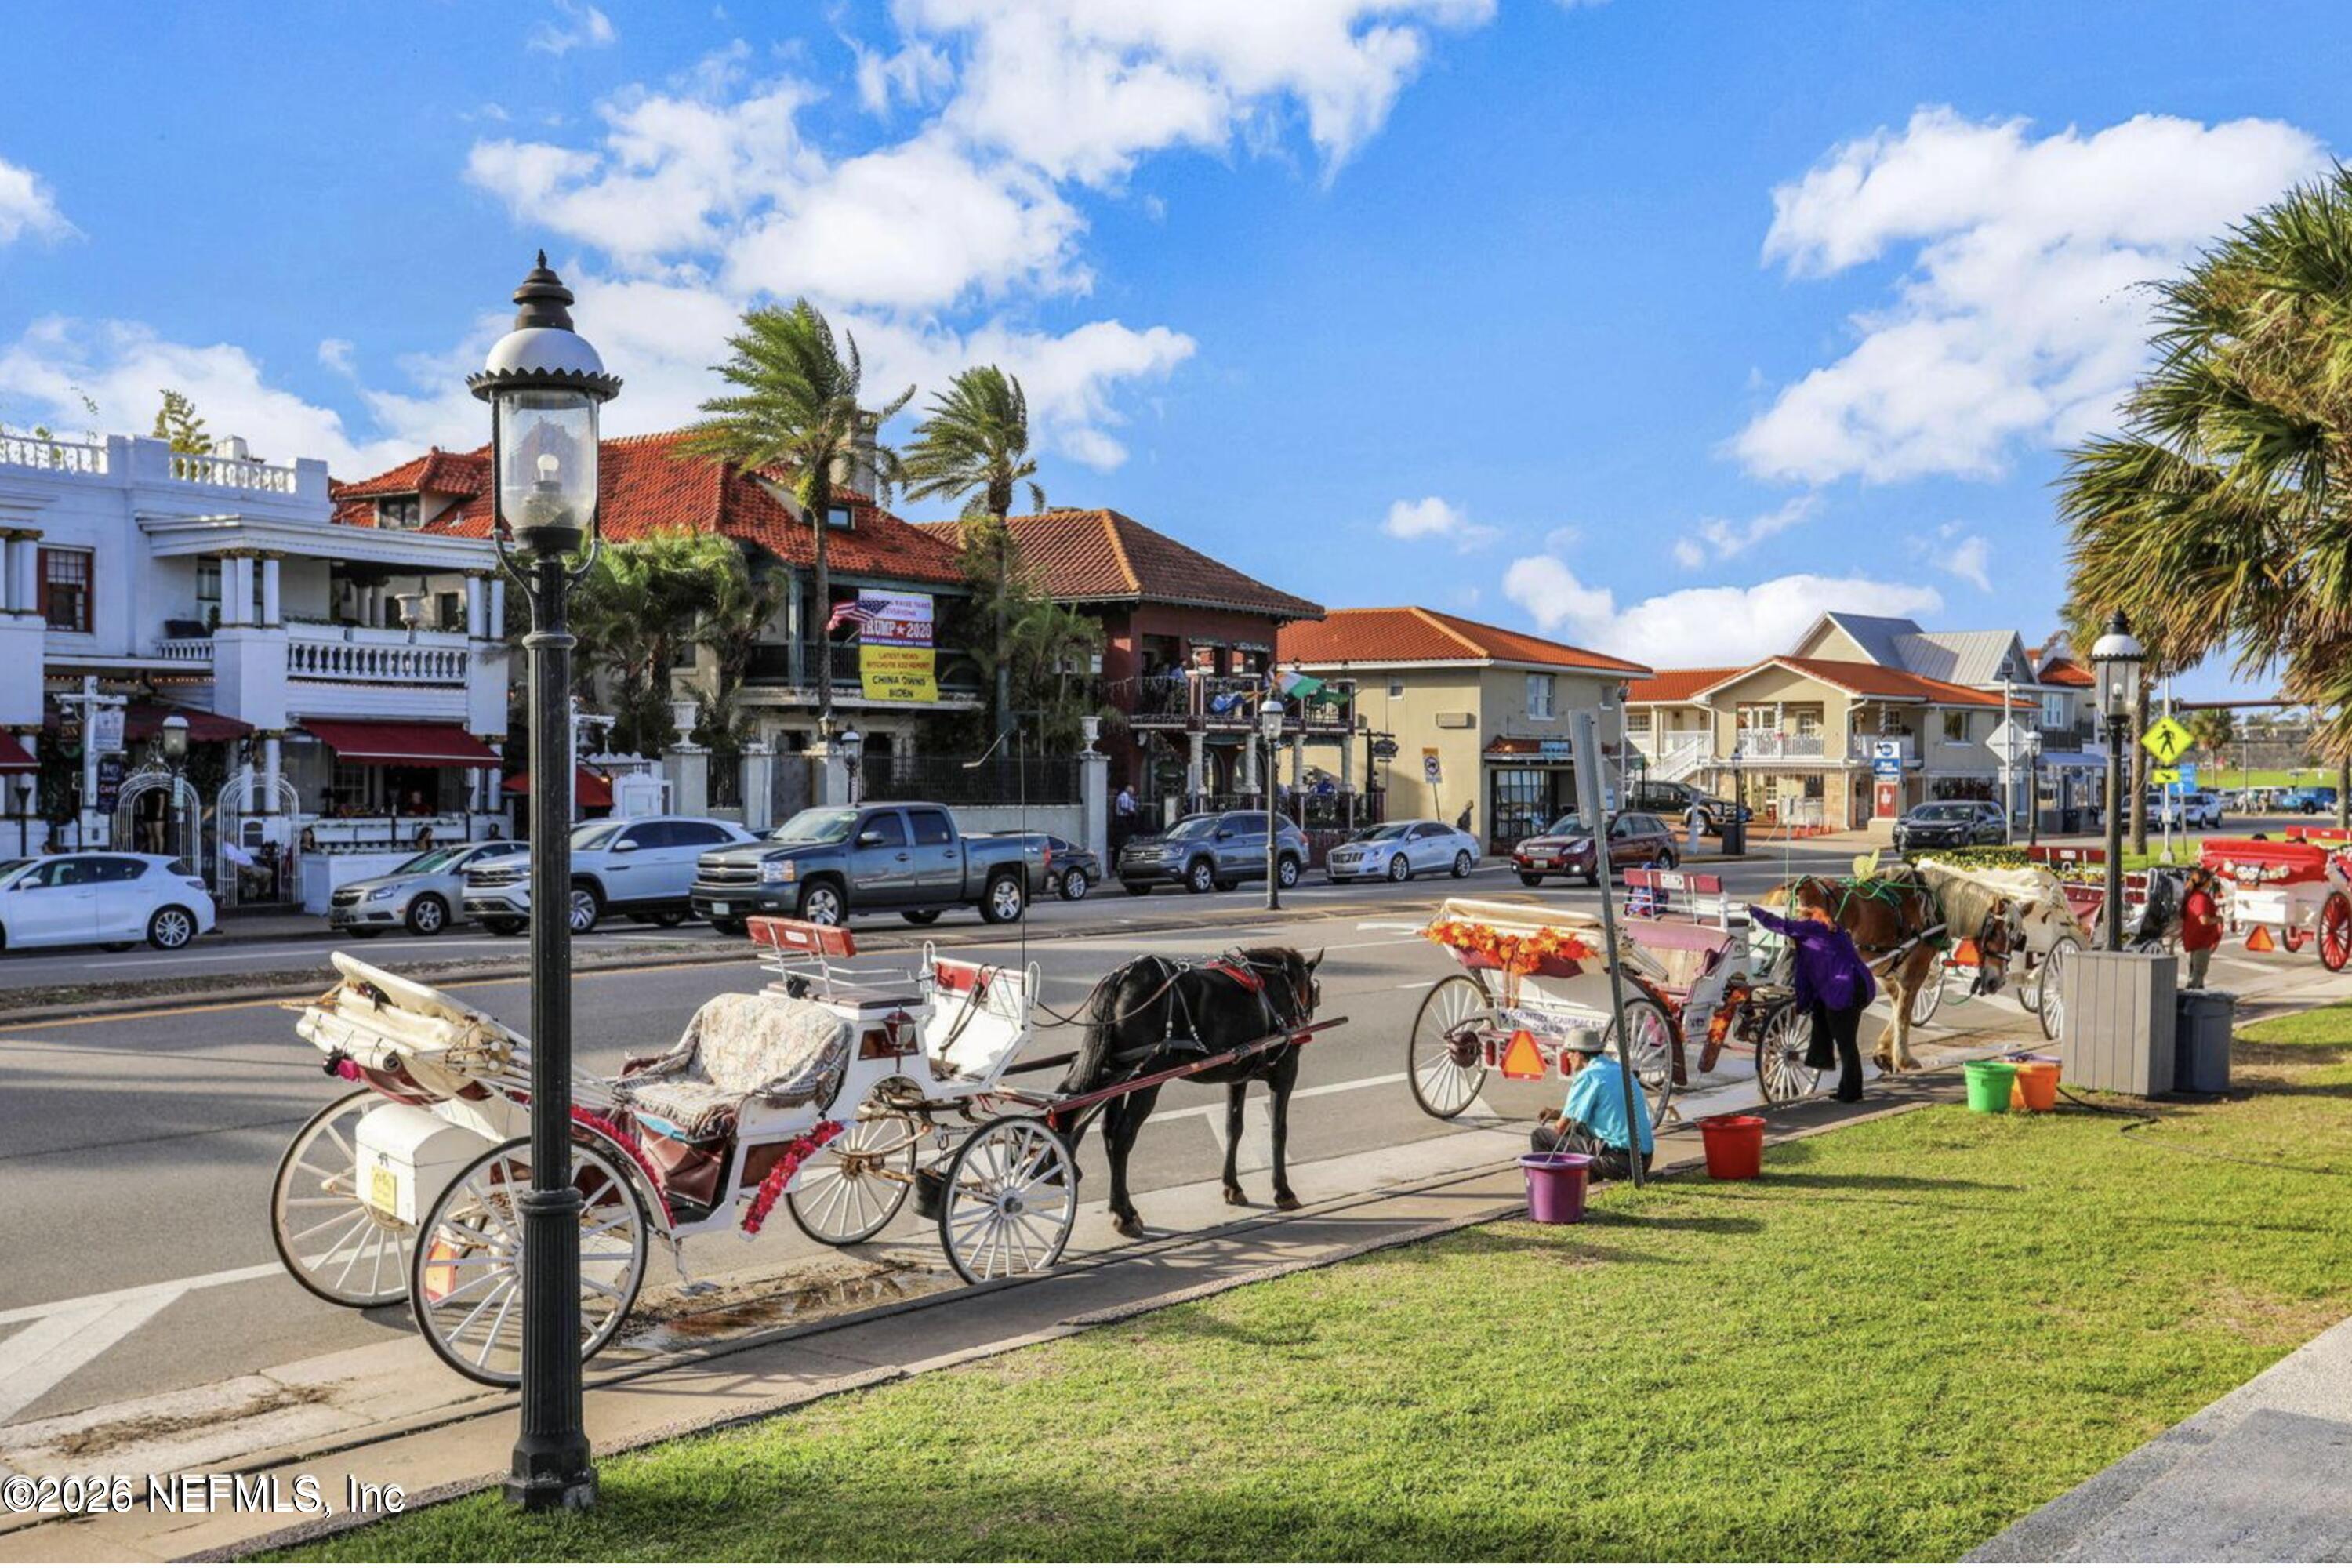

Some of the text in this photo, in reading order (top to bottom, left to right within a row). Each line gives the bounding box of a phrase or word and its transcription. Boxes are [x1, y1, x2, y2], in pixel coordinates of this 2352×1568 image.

[861, 619, 932, 638] TRUMP 2020
[889, 689, 913, 698] BIDEN
